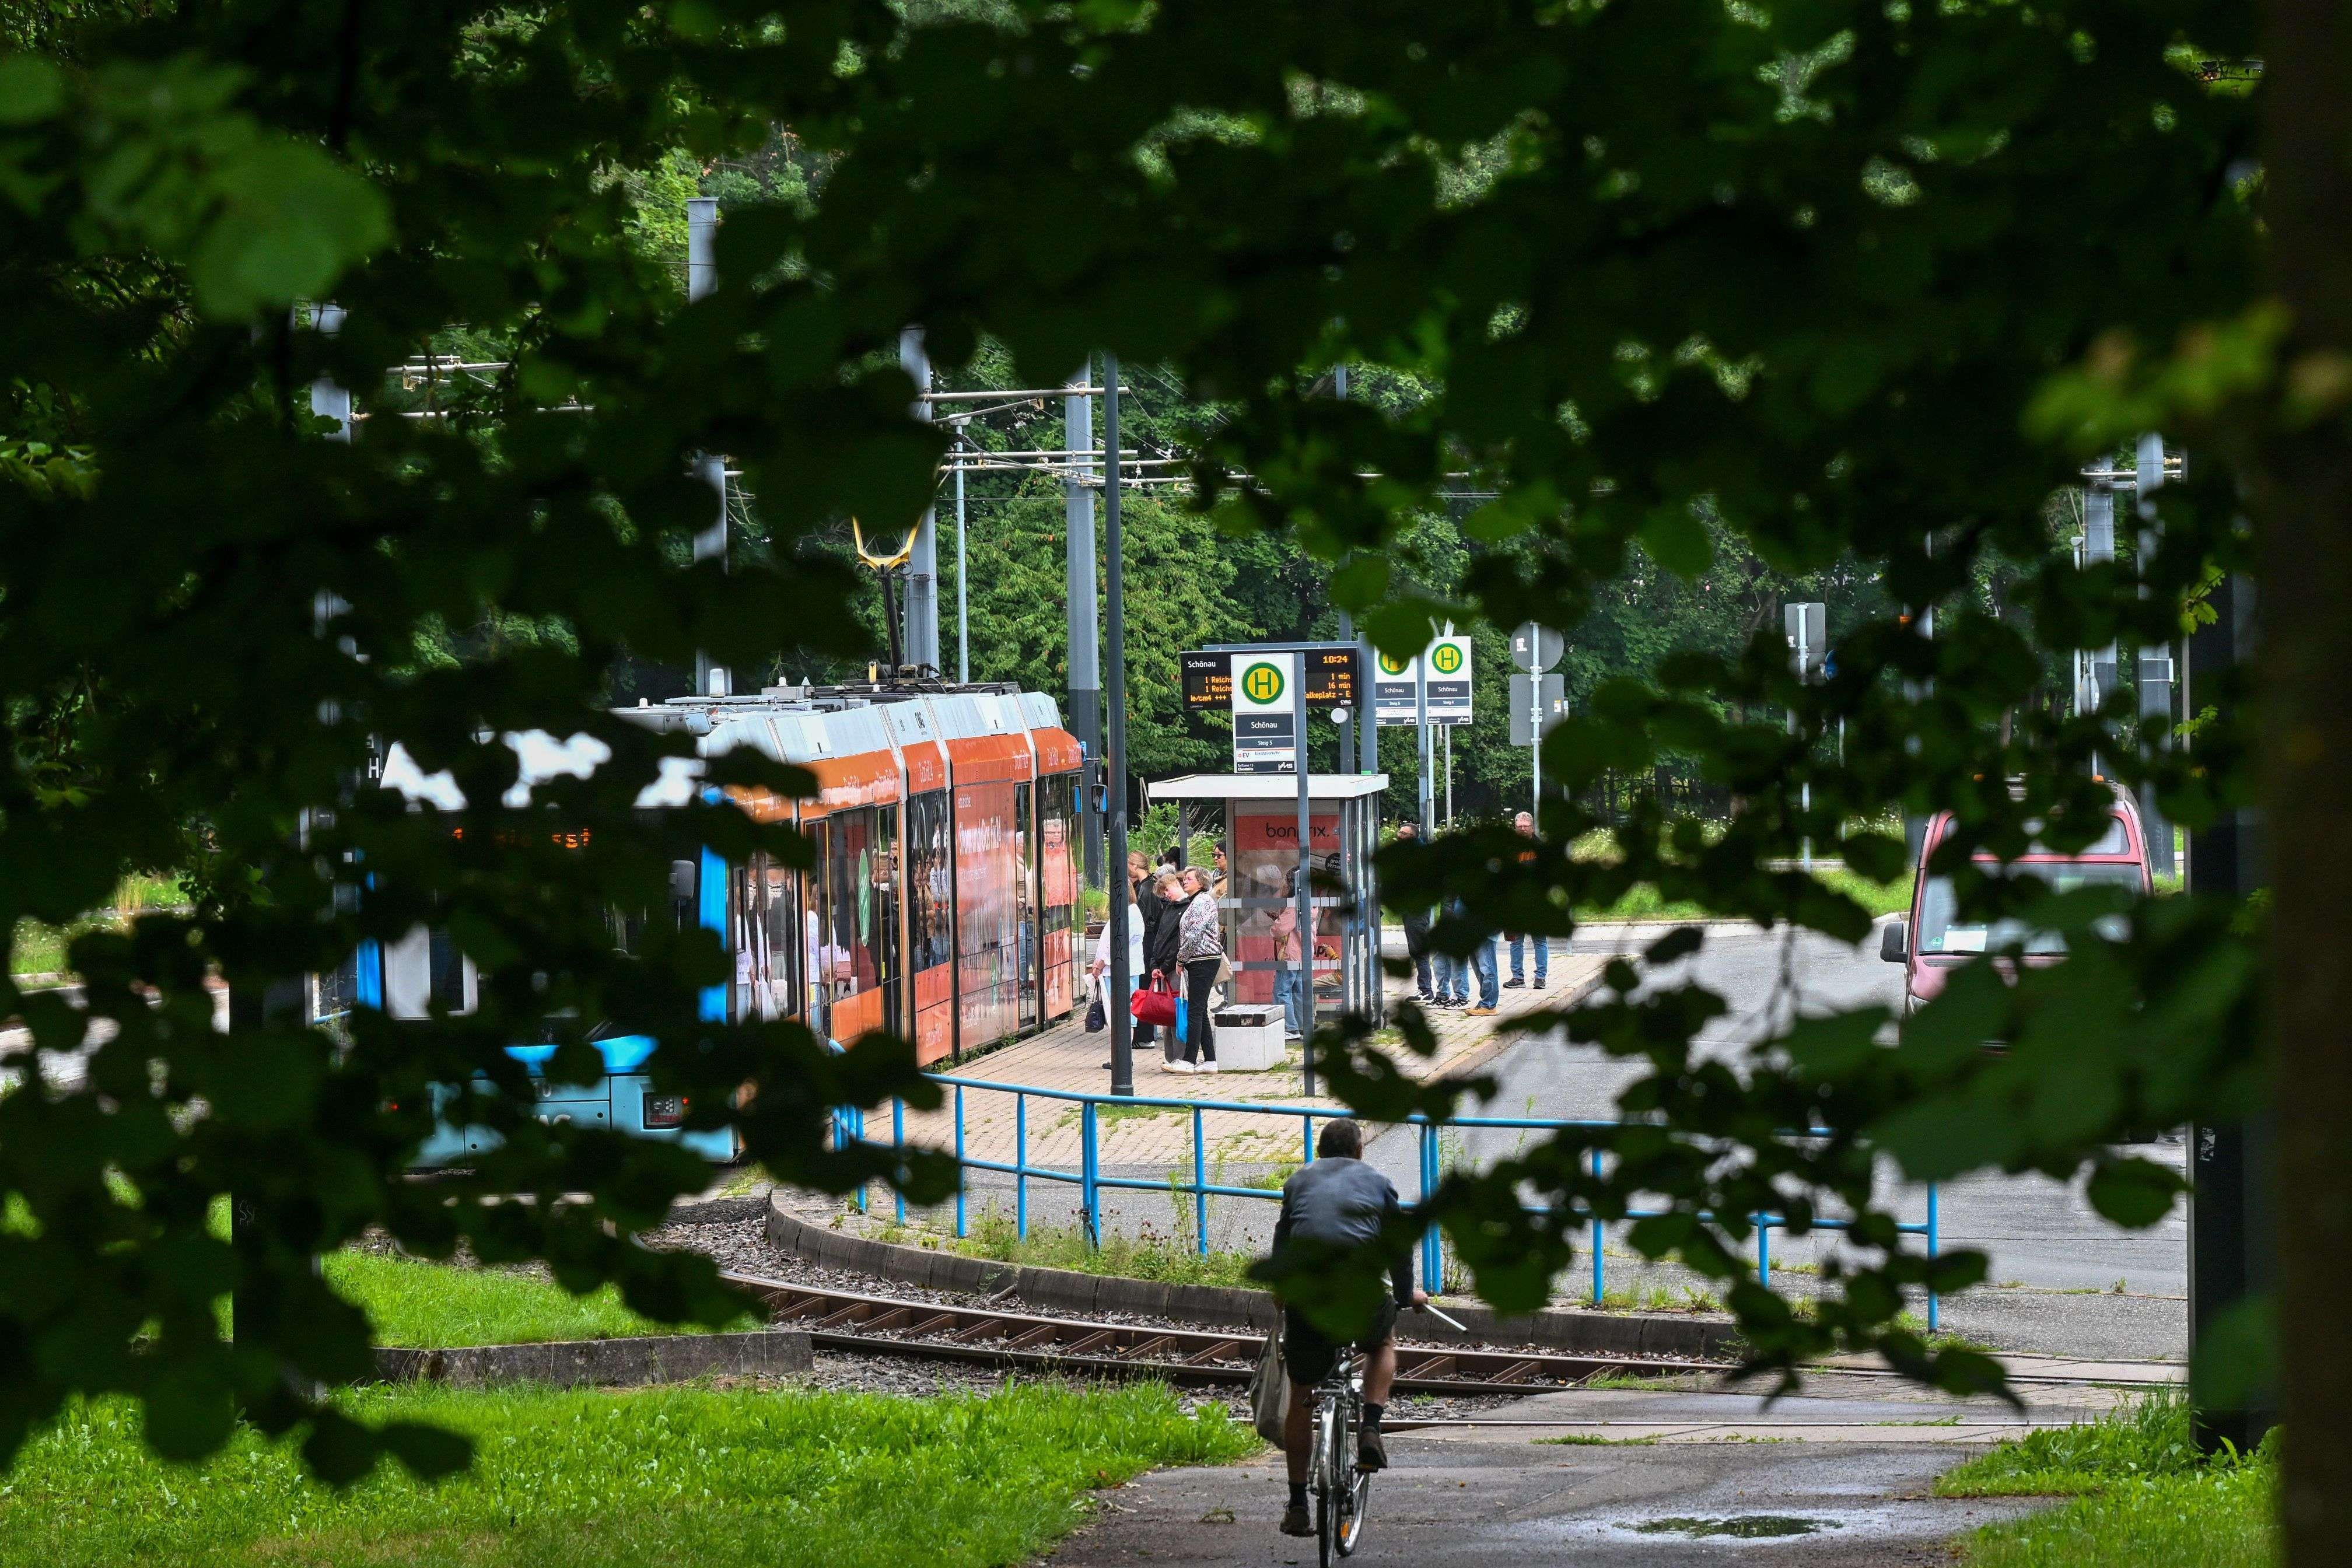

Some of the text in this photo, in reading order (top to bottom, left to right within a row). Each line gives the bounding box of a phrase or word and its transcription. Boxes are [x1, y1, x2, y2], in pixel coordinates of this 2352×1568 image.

[1322, 655, 1348, 663] 10:24
[1441, 649, 1454, 668] H
[1255, 671, 1272, 695] H
[1266, 822, 1330, 841] bonix.
